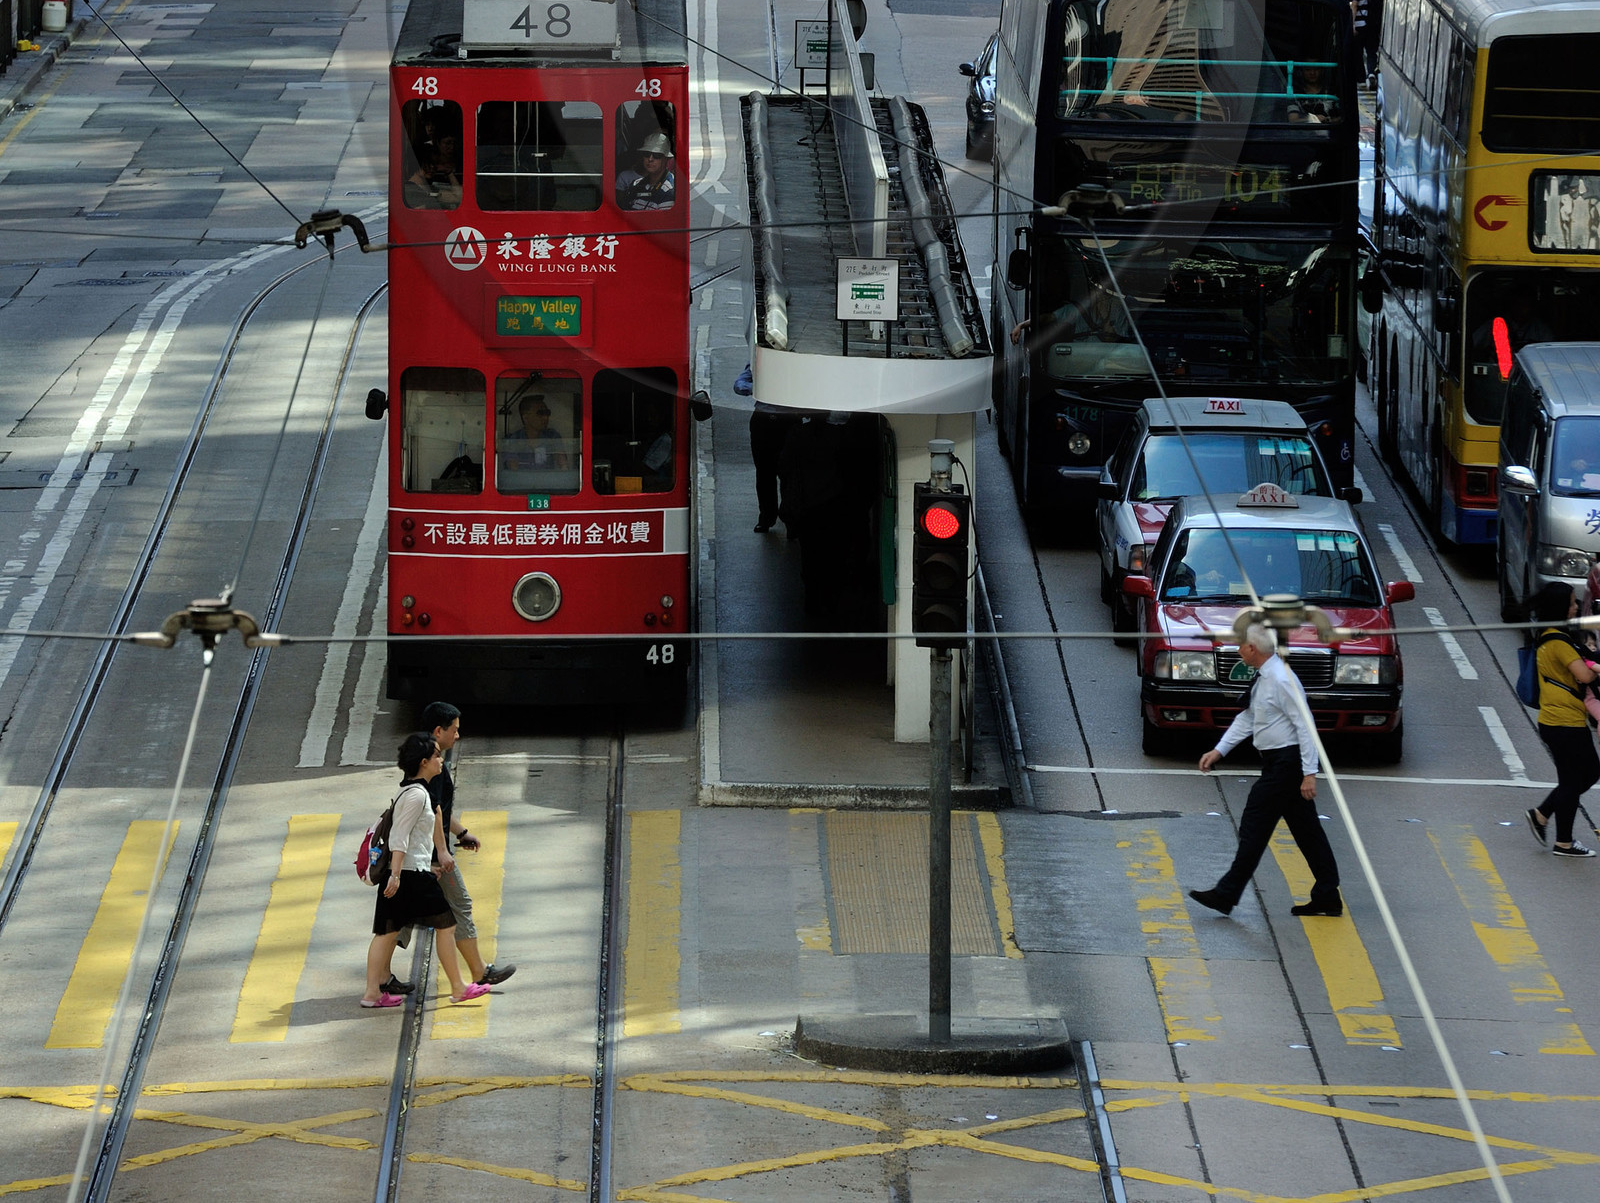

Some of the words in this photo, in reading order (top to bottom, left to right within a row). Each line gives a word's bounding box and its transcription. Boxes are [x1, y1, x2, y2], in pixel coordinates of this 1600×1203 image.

[508, 3, 572, 38] 48
[411, 77, 438, 96] 48
[635, 79, 662, 97] 48
[1130, 184, 1165, 200] Pak
[1175, 184, 1202, 201] Tin
[1225, 167, 1283, 203] 104
[495, 232, 619, 260] 永隆銀行
[498, 263, 534, 272] WING
[539, 264, 575, 272] LUNG
[580, 264, 617, 272] BANK
[845, 265, 857, 273] 27E
[498, 300, 536, 315] Happy
[541, 300, 577, 316] Valley
[505, 316, 570, 330] 跑馬地
[1210, 400, 1240, 411] TAXI
[1065, 408, 1099, 421] 1178
[1250, 493, 1286, 503] TAXI
[1258, 486, 1278, 495] 的士
[529, 499, 549, 509] 138
[423, 522, 651, 546] 不設最低證券佣金收費
[646, 644, 675, 665] 48
[1247, 666, 1255, 675] 5
